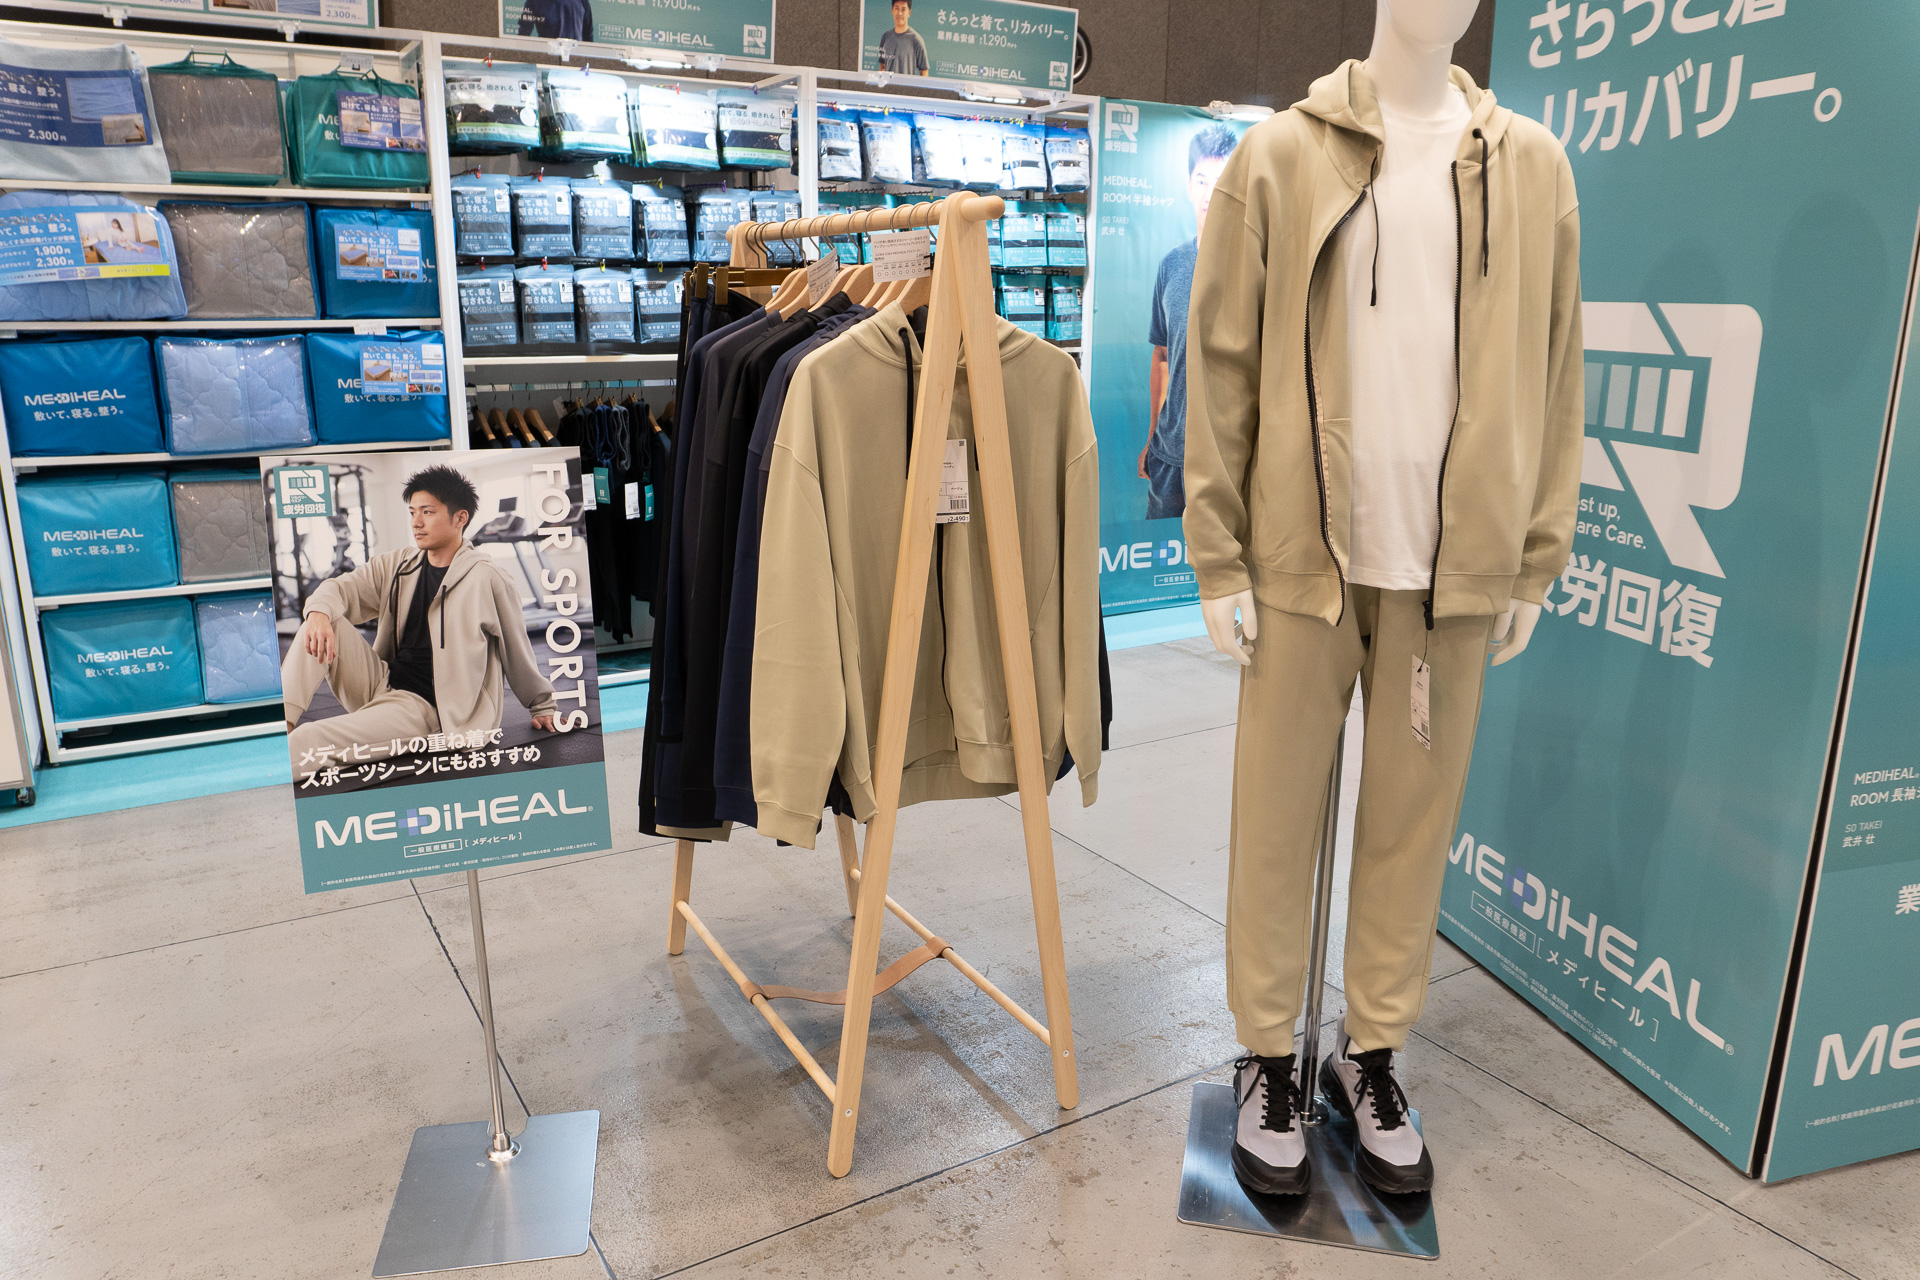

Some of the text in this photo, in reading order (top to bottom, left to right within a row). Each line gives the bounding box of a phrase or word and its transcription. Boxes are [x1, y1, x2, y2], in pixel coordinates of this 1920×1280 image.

[937, 9, 1069, 41] さらっと着て、リカバリー。
[1543, 55, 1842, 155] リカバリー。
[28, 129, 67, 142] 2,300円
[1102, 193, 1174, 208] ROOM 半袖シャツ
[1102, 216, 1129, 225] SO TAKEI
[34, 245, 71, 256] 1,900円
[35, 256, 75, 267] 2,300円
[34, 405, 124, 421] 敷いて、寝る。整う。
[283, 503, 327, 515] 疲労回復
[1598, 502, 1621, 522] up,
[1605, 524, 1647, 550] Care.
[51, 544, 140, 557] 敷いて、寝る。整う。
[532, 462, 589, 733] FOR SPORTS
[84, 664, 170, 678] 敷いて、寝る。整う。
[298, 728, 503, 767] メディヒールの重ね着で
[300, 745, 541, 789] スポーツシーンにもおすすめ
[1850, 786, 1920, 807] ROOM 長袖
[1845, 820, 1883, 833] SO TAKEI
[1842, 833, 1876, 848] 武井 壮
[410, 842, 455, 855] 一般医療機器
[1478, 901, 1527, 943] 一般医療機器
